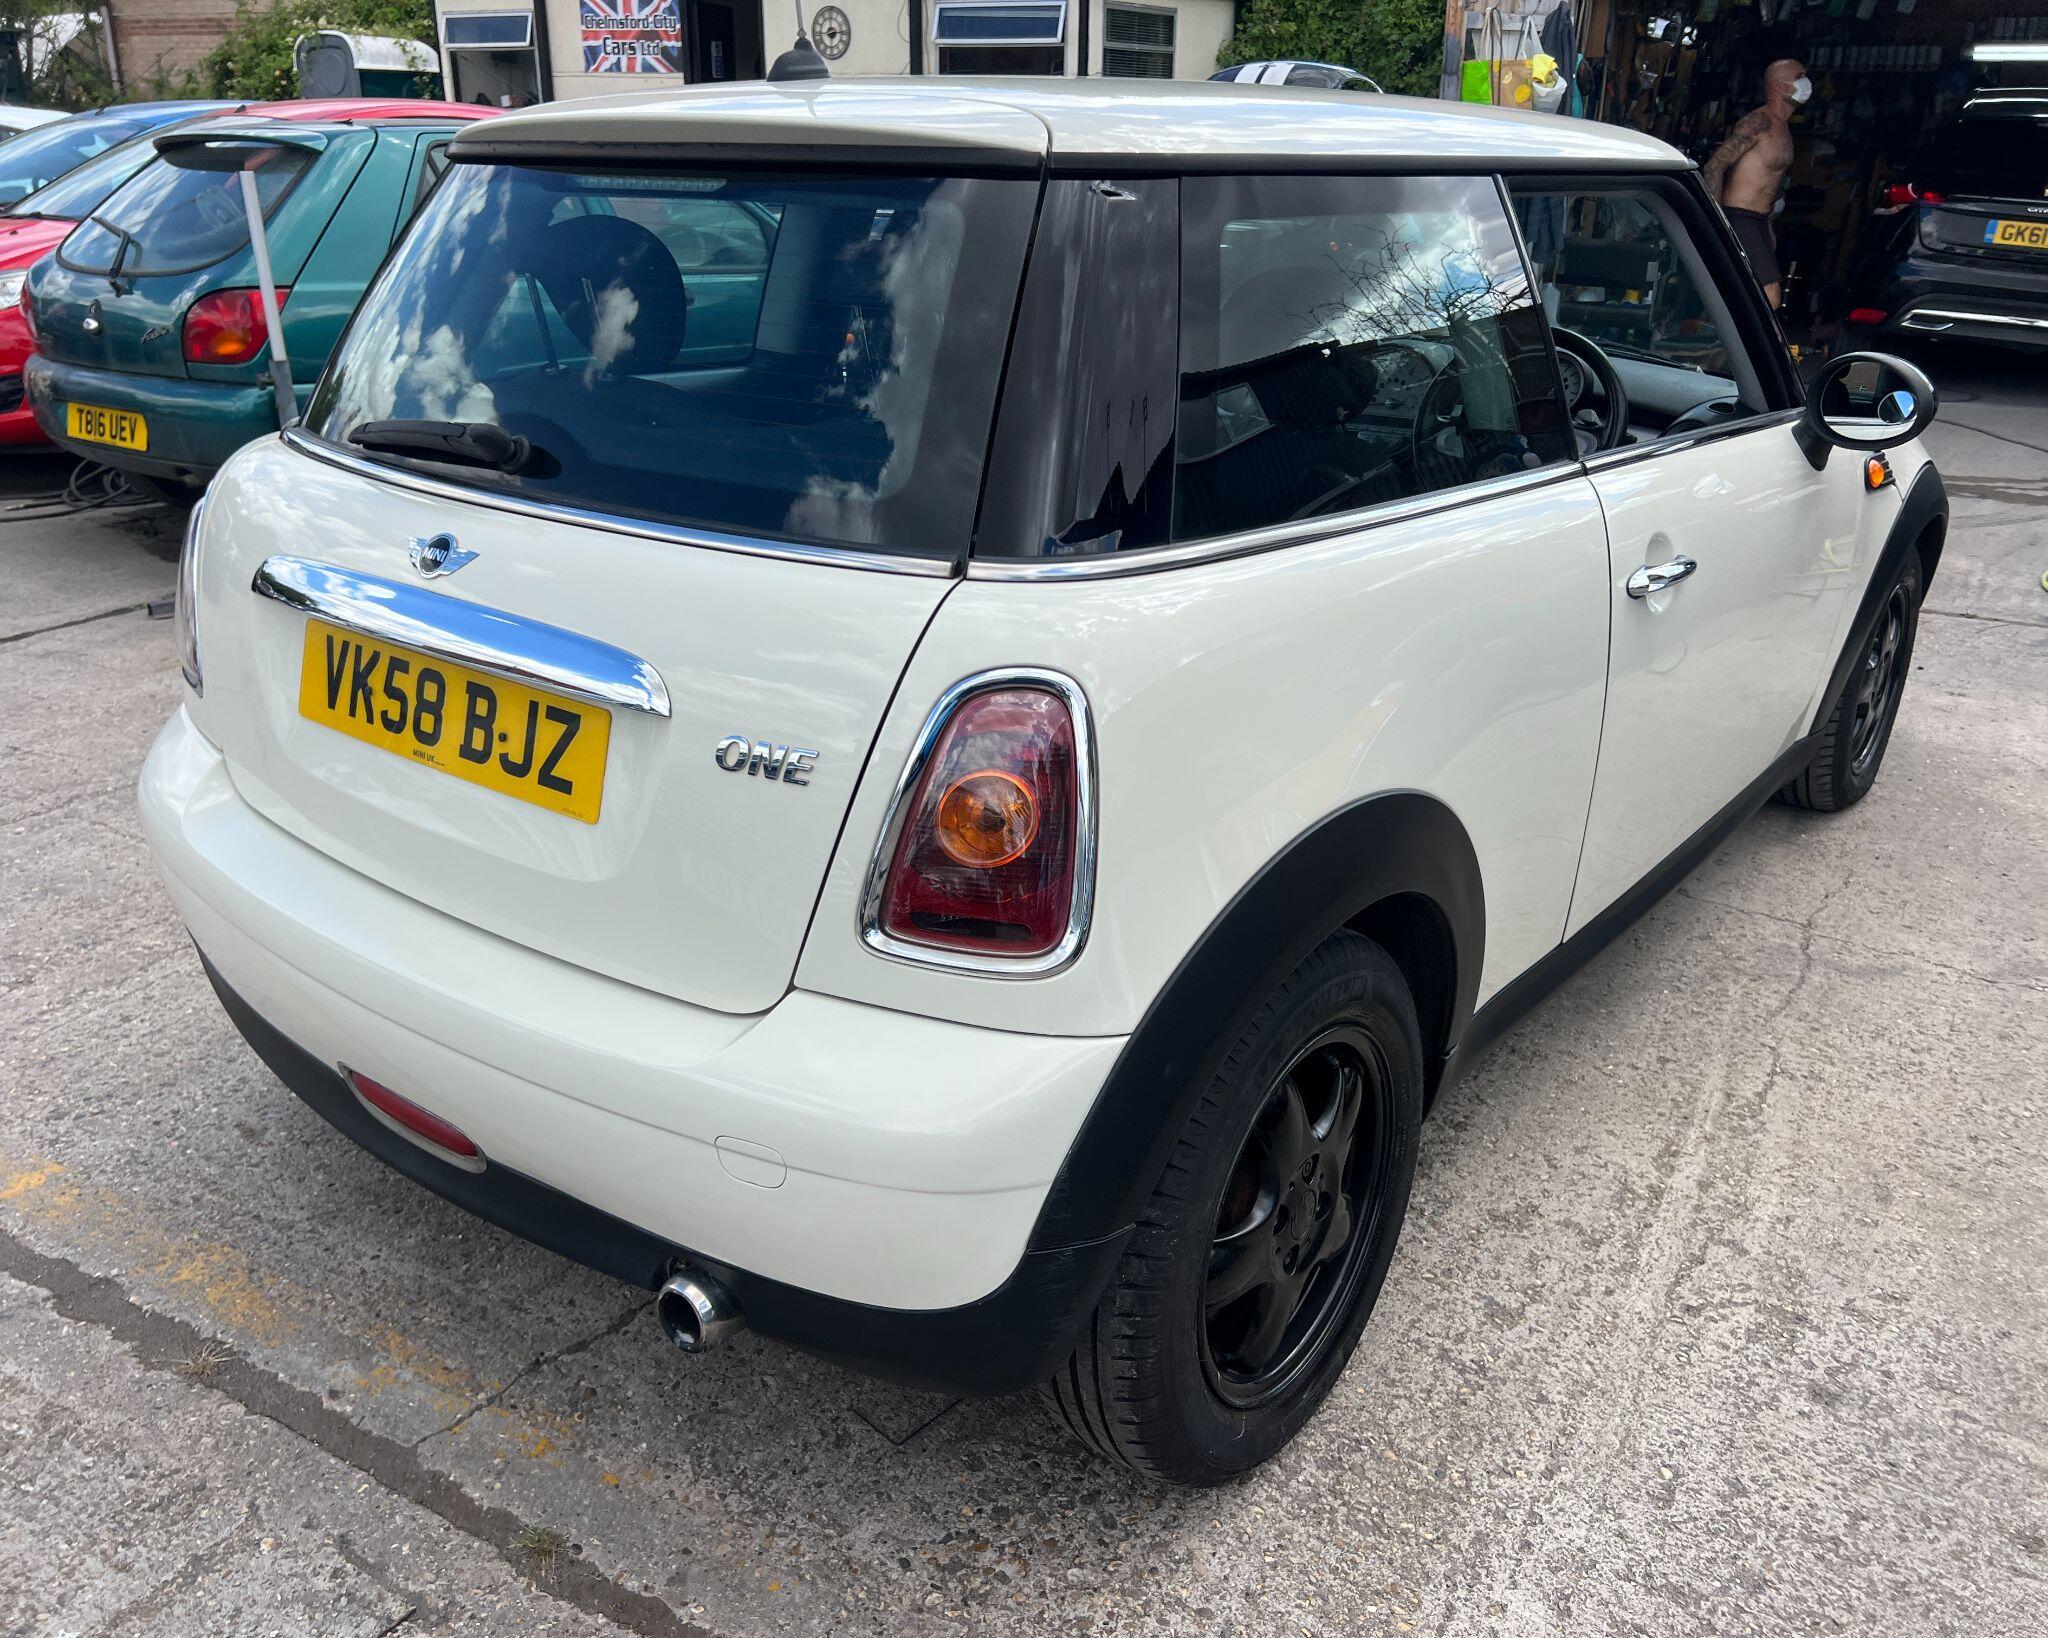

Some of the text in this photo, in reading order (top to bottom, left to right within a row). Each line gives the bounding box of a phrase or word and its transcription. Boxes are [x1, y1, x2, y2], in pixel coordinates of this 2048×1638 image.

[584, 13, 676, 32] Chelmsford City
[603, 36, 661, 56] Cars Ltd
[77, 407, 137, 444] T816 UEV
[422, 546, 448, 563] MINI
[326, 634, 582, 796] VK58 BJZ
[715, 734, 820, 787] ONE
